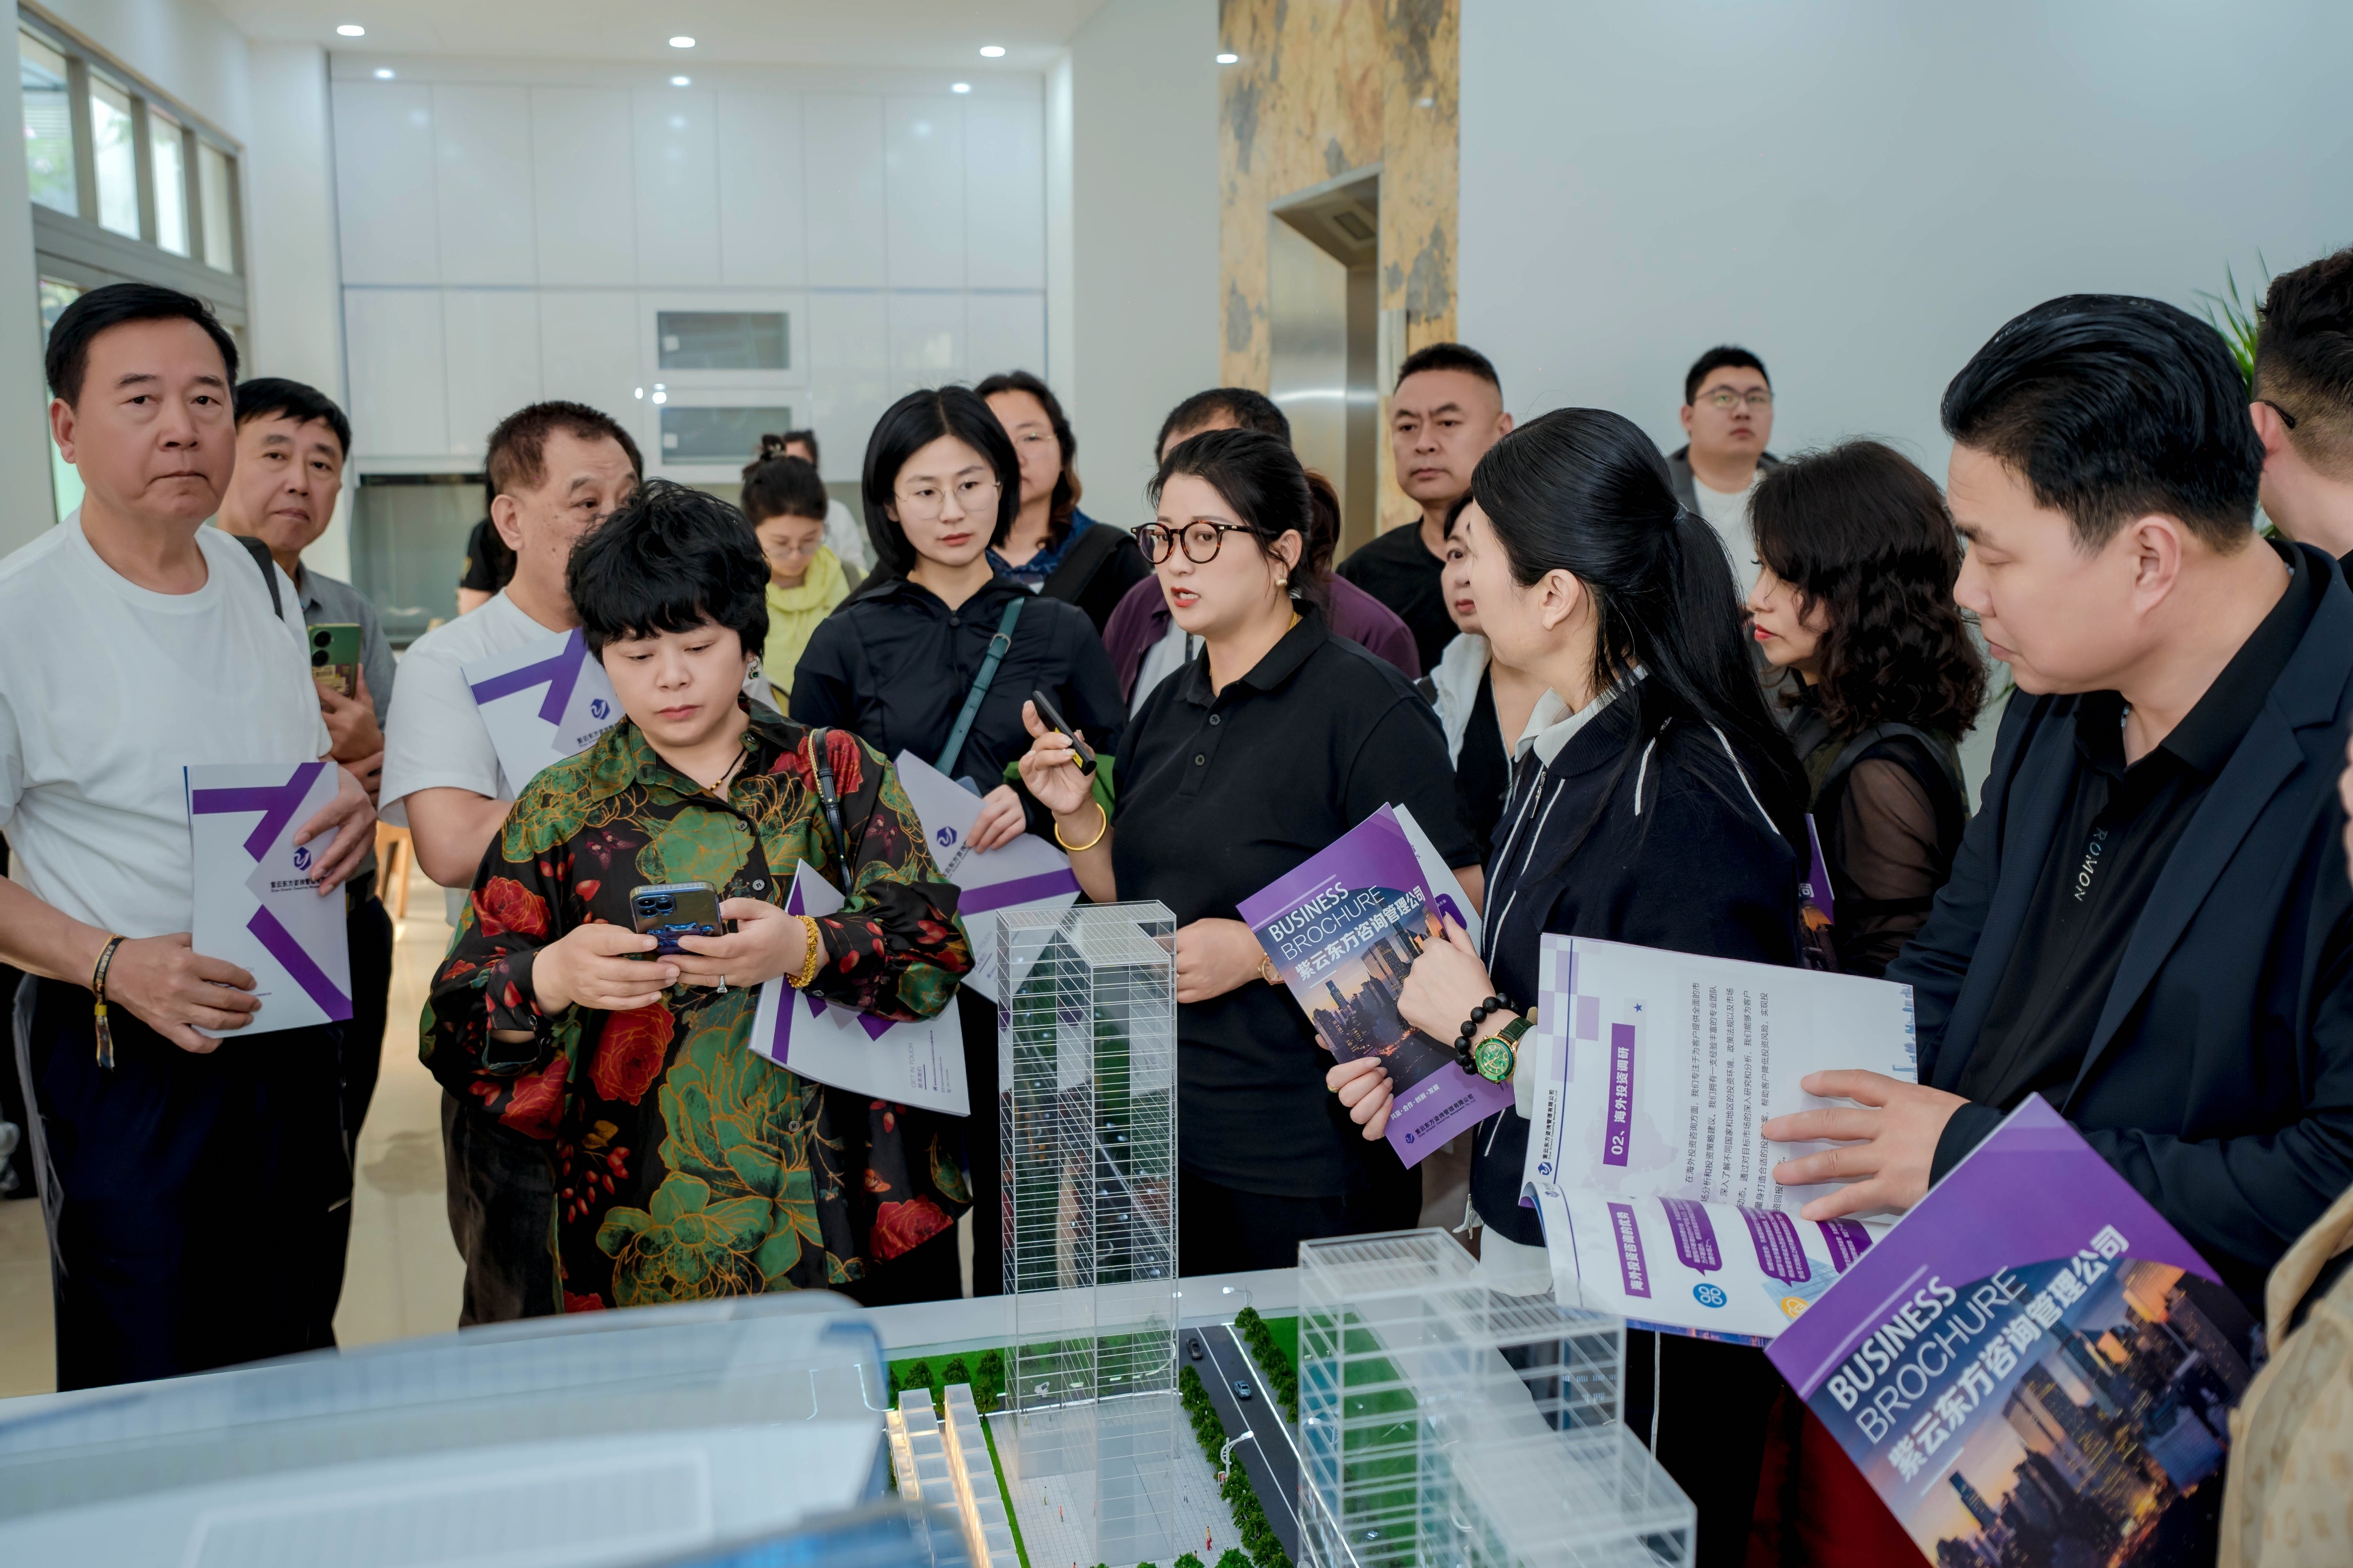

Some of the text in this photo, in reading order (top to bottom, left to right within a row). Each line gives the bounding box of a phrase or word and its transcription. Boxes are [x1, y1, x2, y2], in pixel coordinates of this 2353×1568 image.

[2075, 827, 2108, 901] ROMON
[1268, 882, 1348, 942] BUSINESS
[1281, 885, 1385, 960] BROCHURE
[1295, 885, 1426, 981] 紫云东方咨询管理公司
[1415, 1093, 1474, 1135] 紫云东方咨询管理有限公司
[1542, 1089, 1554, 1159] 紫云东方咨询管理有限公司
[1754, 993, 1769, 1210] 量身打造合适的投资案，帮助客户降低投资风险，实现投
[1827, 1276, 1957, 1412] BUSINESS
[1855, 1265, 2028, 1445] BROCHURE
[1887, 1224, 2129, 1483] 紫云东方咨询管理公司
